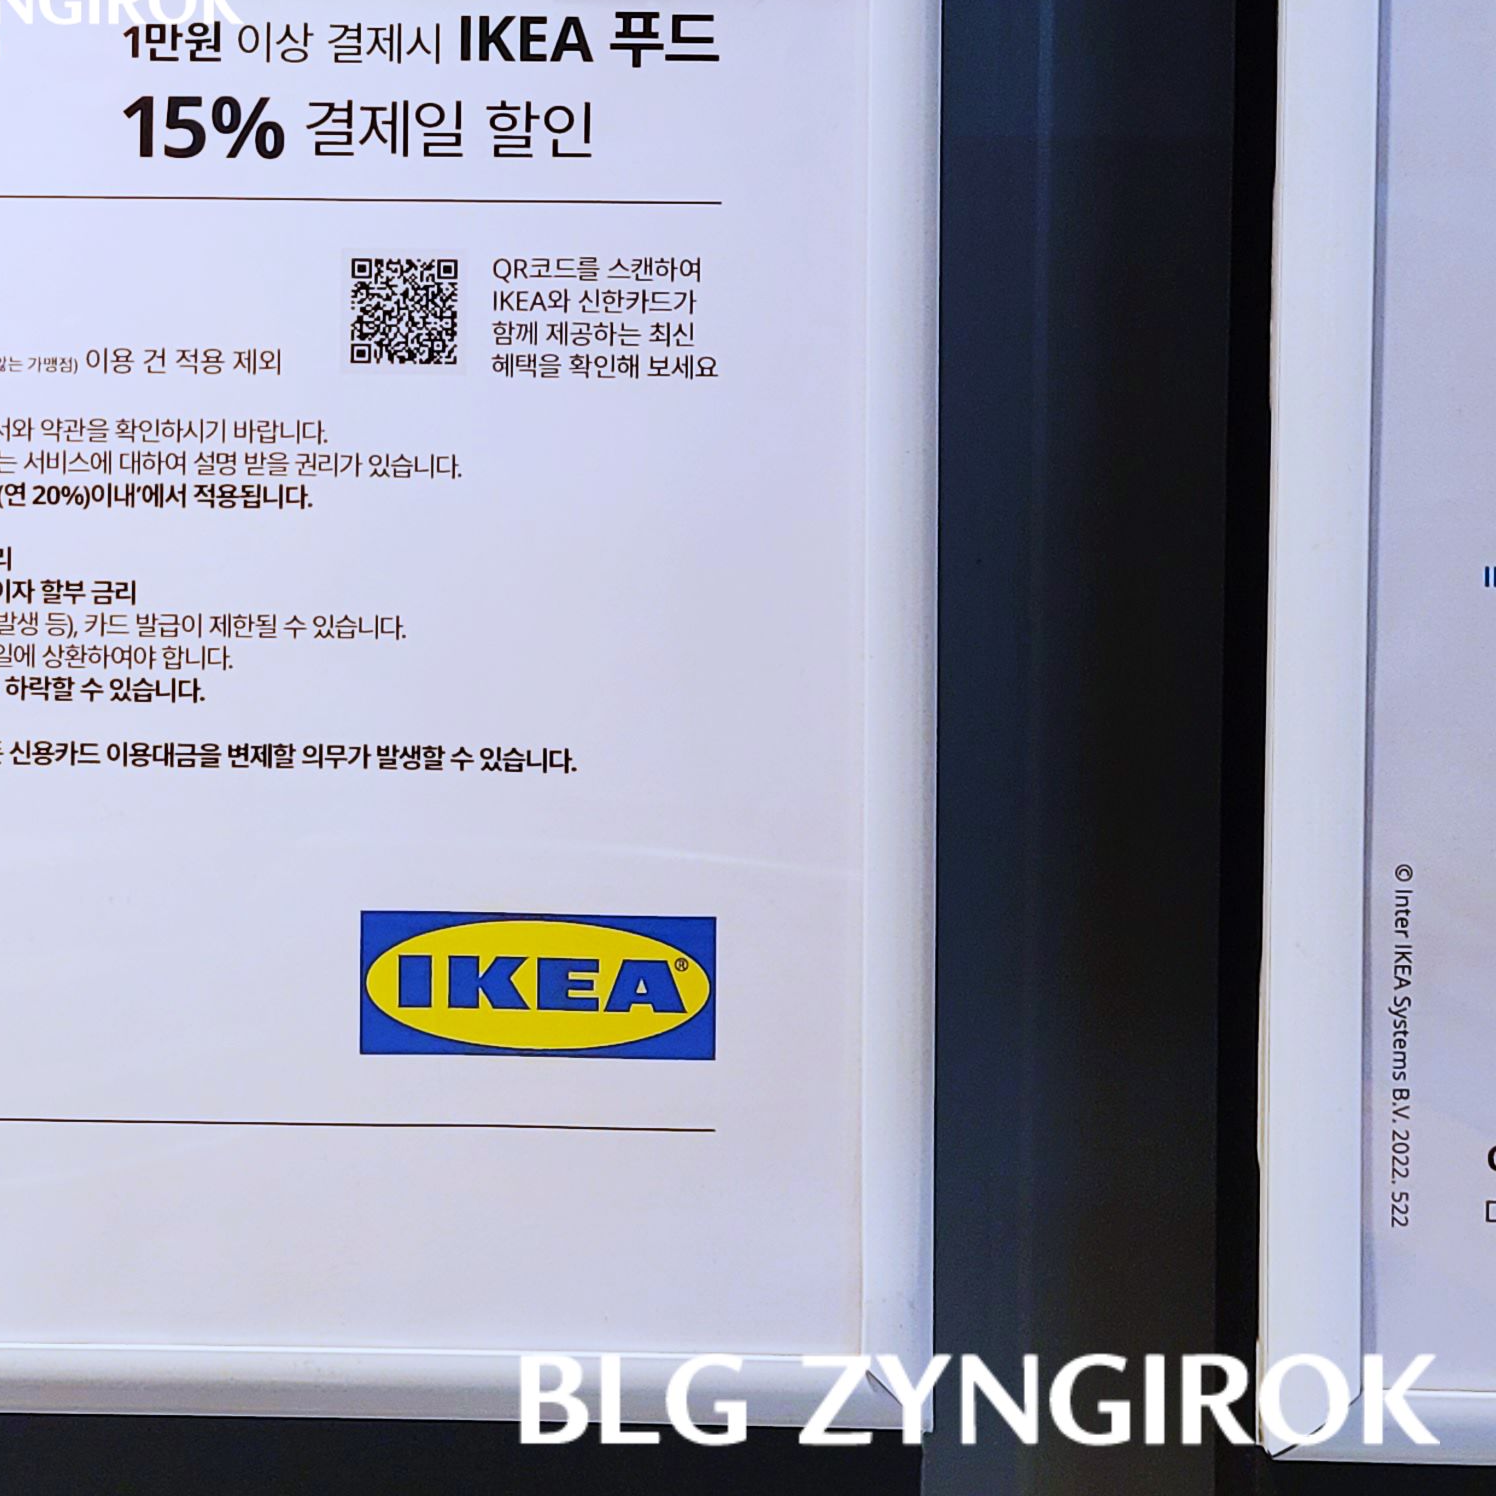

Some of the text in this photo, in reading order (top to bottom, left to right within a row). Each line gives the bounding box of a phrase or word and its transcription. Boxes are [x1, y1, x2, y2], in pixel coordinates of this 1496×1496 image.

[122, 10, 721, 69] 1만원 이상 결제시 IKEA 푸드
[122, 95, 593, 161] 15% 결제일 할인
[492, 256, 701, 284] QR코드를 스캔하여
[492, 287, 698, 316] IKEA와 신한카드가
[491, 319, 696, 349] 함께 제공하는 최신
[84, 346, 138, 377] 이용
[143, 346, 167, 375] 건
[175, 347, 227, 376] 적용
[232, 347, 281, 377] 제외
[490, 352, 720, 382] 혜택을 확인해 보세요
[40, 416, 111, 444] 약관을
[114, 417, 226, 445] 확인하시기
[233, 418, 329, 446] 바랍니다.
[192, 482, 314, 511] 적용됩니다.
[3, 674, 77, 702] 하락할
[79, 676, 105, 704] 수
[108, 675, 206, 705] 있습니다.
[1393, 889, 1414, 939] Inter
[1392, 943, 1413, 991] IKEA
[1388, 995, 1412, 1082] Systems
[1390, 1190, 1410, 1228] 522
